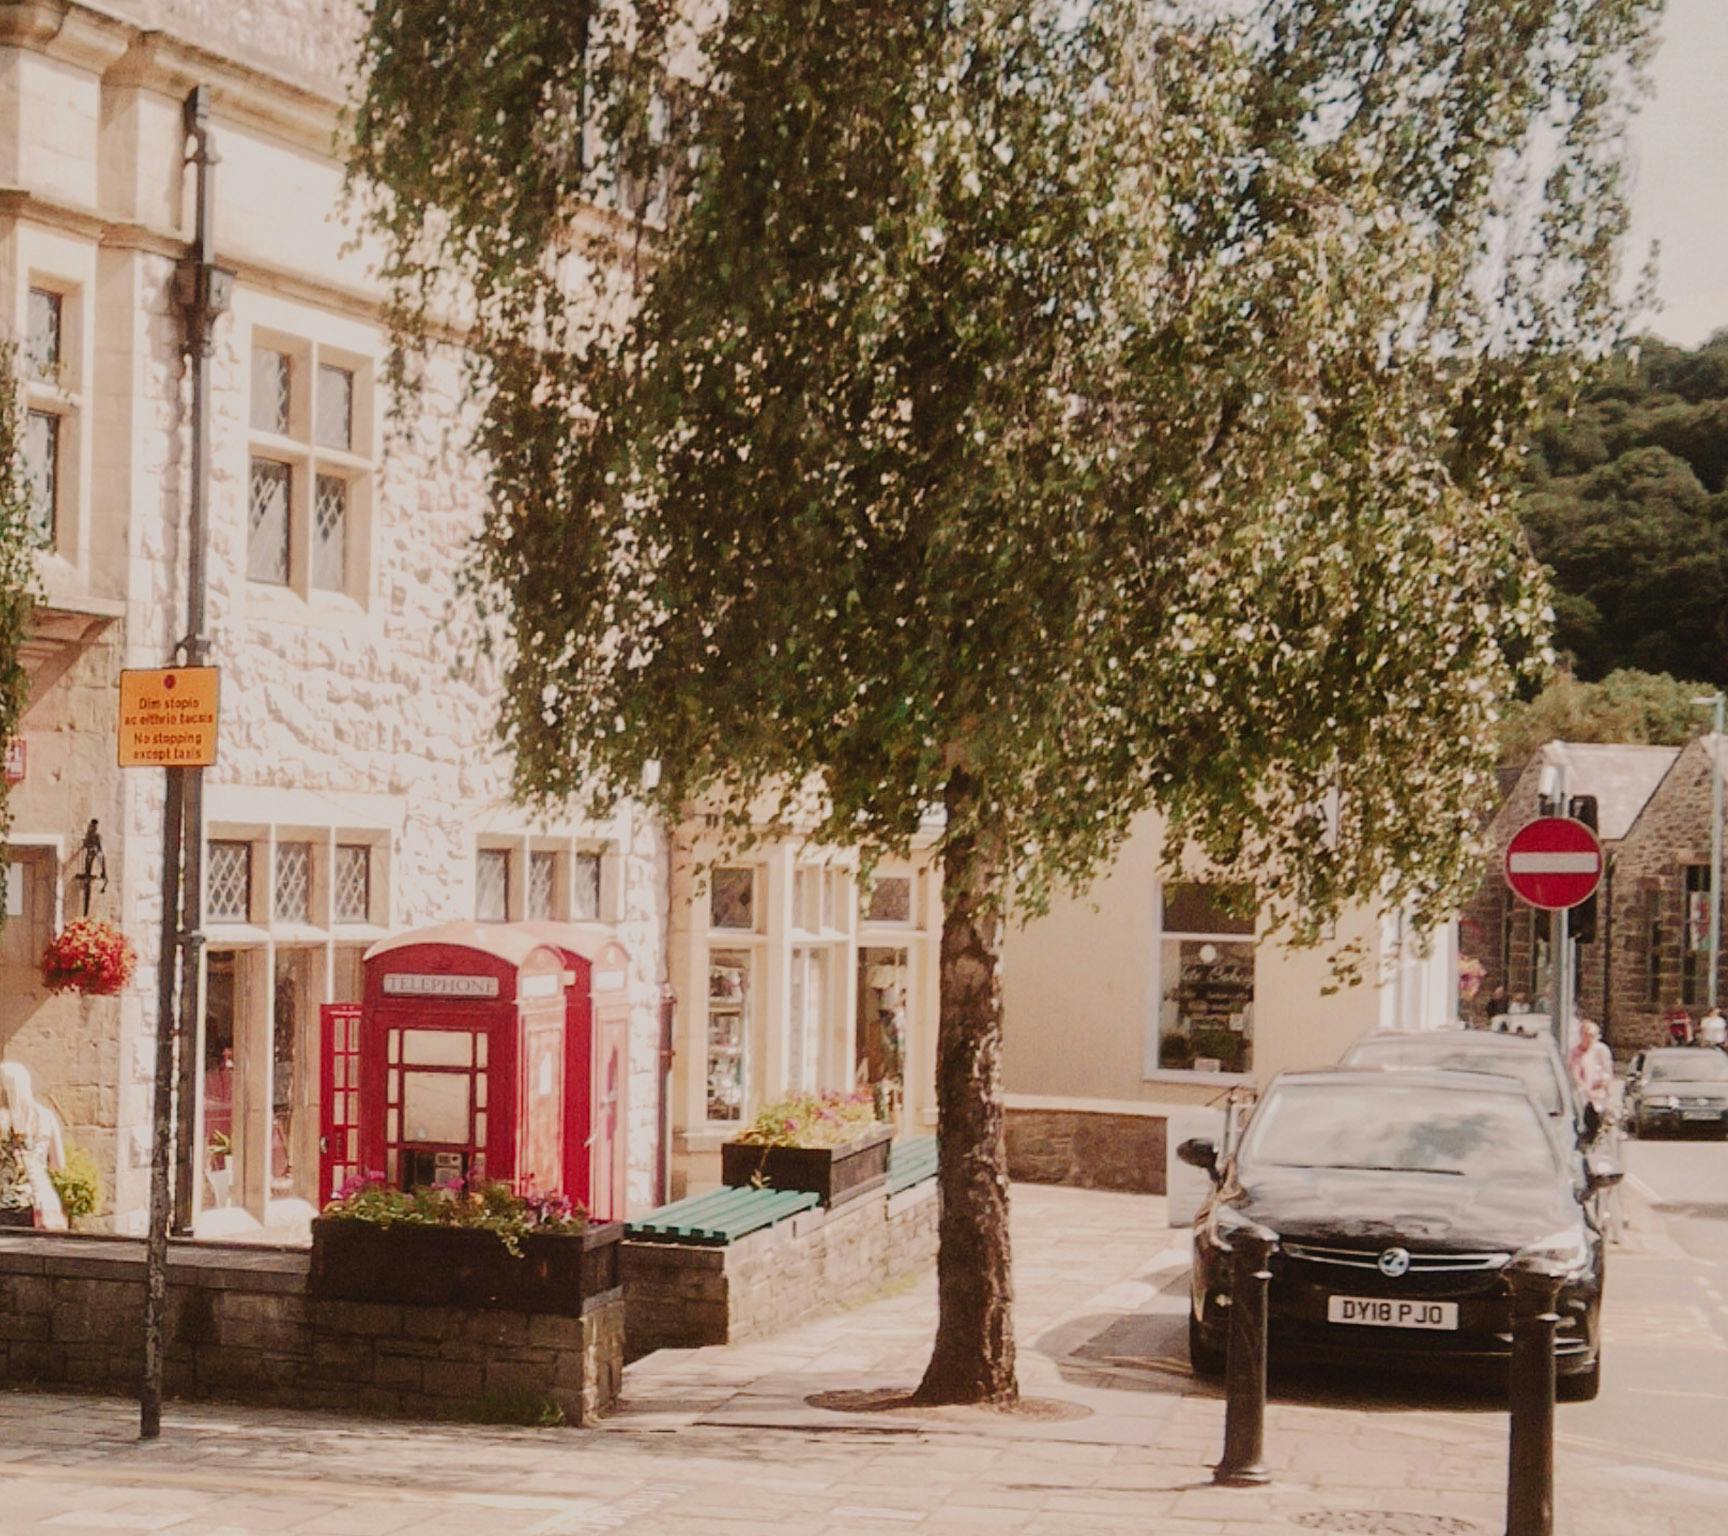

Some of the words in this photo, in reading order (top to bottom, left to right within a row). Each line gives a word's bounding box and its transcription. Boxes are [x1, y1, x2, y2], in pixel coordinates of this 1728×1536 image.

[139, 697, 161, 710] Dim
[164, 697, 200, 710] stopio
[124, 716, 137, 725] ac
[140, 712, 177, 725] eithrio
[134, 732, 150, 744] No
[152, 732, 202, 745] stopping
[133, 747, 170, 761] except
[174, 747, 202, 759] taxis
[389, 976, 496, 993] TELEPHONE
[1343, 1300, 1392, 1322] DY18
[1399, 1304, 1443, 1325] PJO
